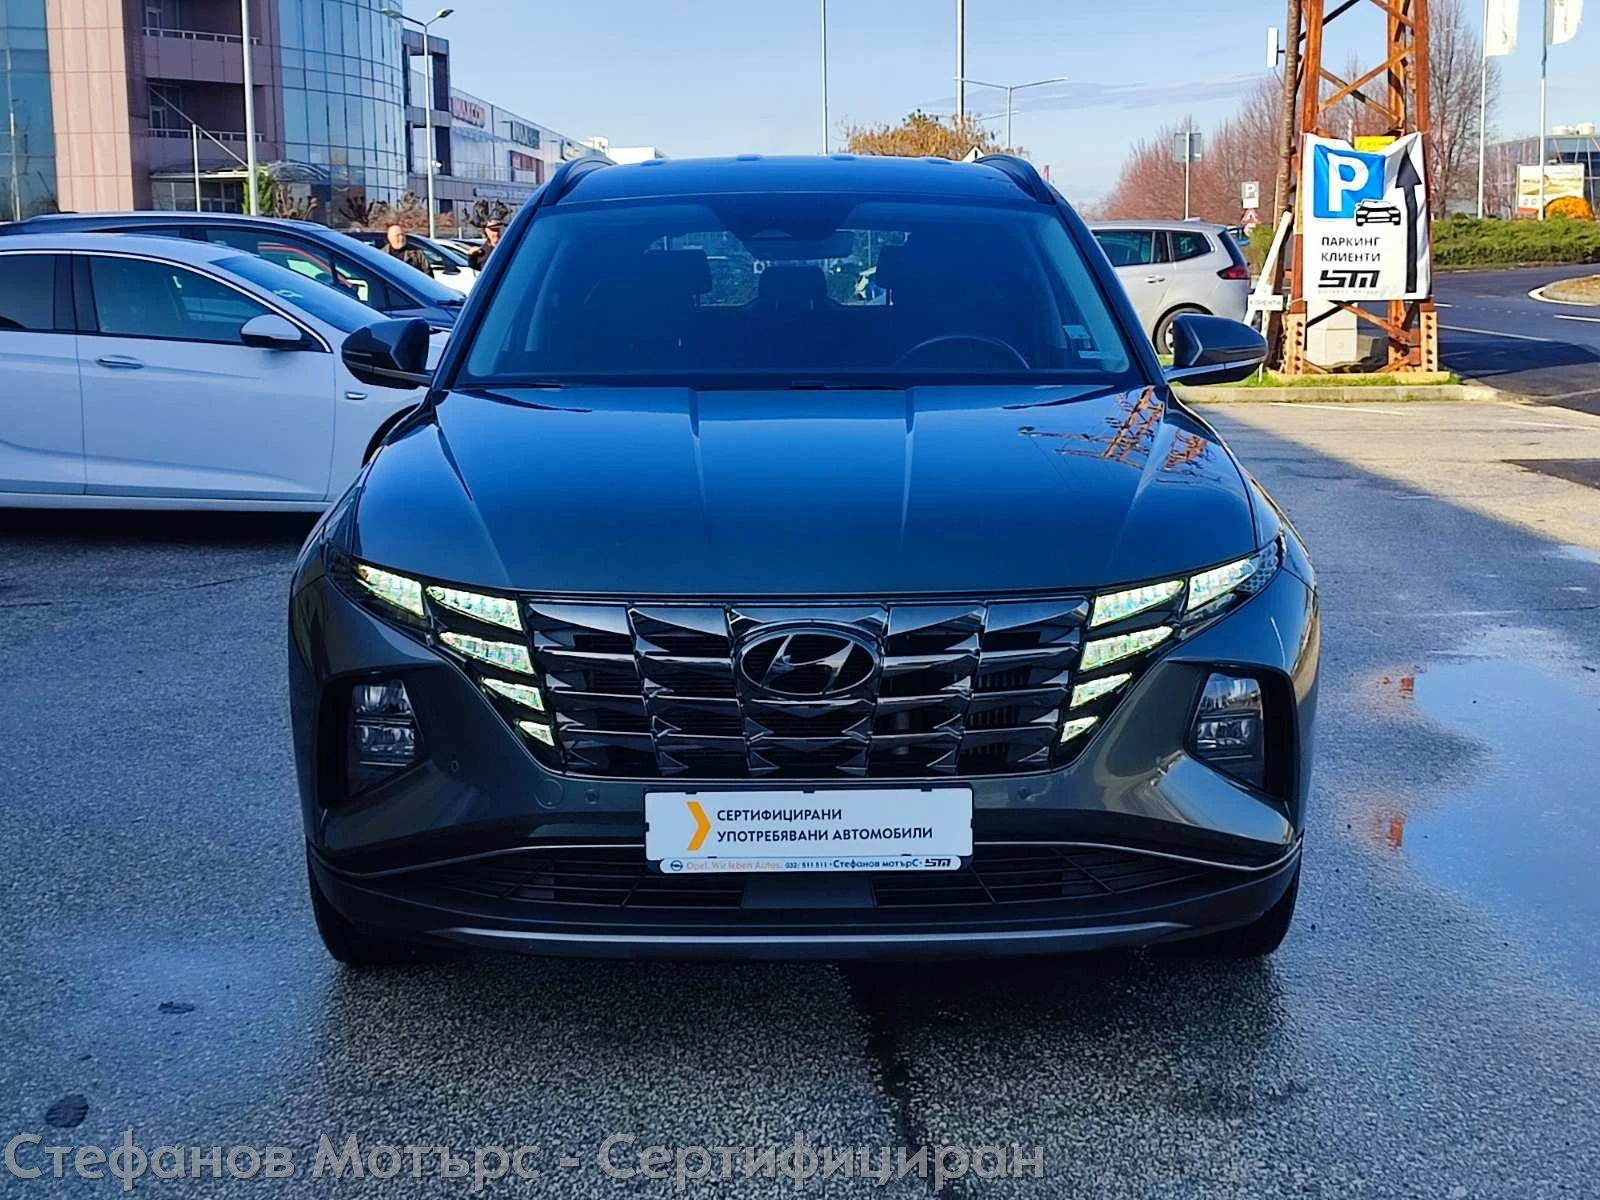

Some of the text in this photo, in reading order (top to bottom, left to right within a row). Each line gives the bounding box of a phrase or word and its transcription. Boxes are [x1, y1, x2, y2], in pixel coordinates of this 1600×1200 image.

[1327, 152, 1369, 212] P
[1321, 236, 1381, 247] ПАРКИНГ
[1321, 252, 1381, 262] КЛИЕНТИ
[717, 808, 842, 823] СЕРТИФИЦИРАНИ
[717, 827, 933, 843] УПОТРЕБЯВАНИ АВТОМОБИЛИ
[833, 859, 880, 871] Стефанов
